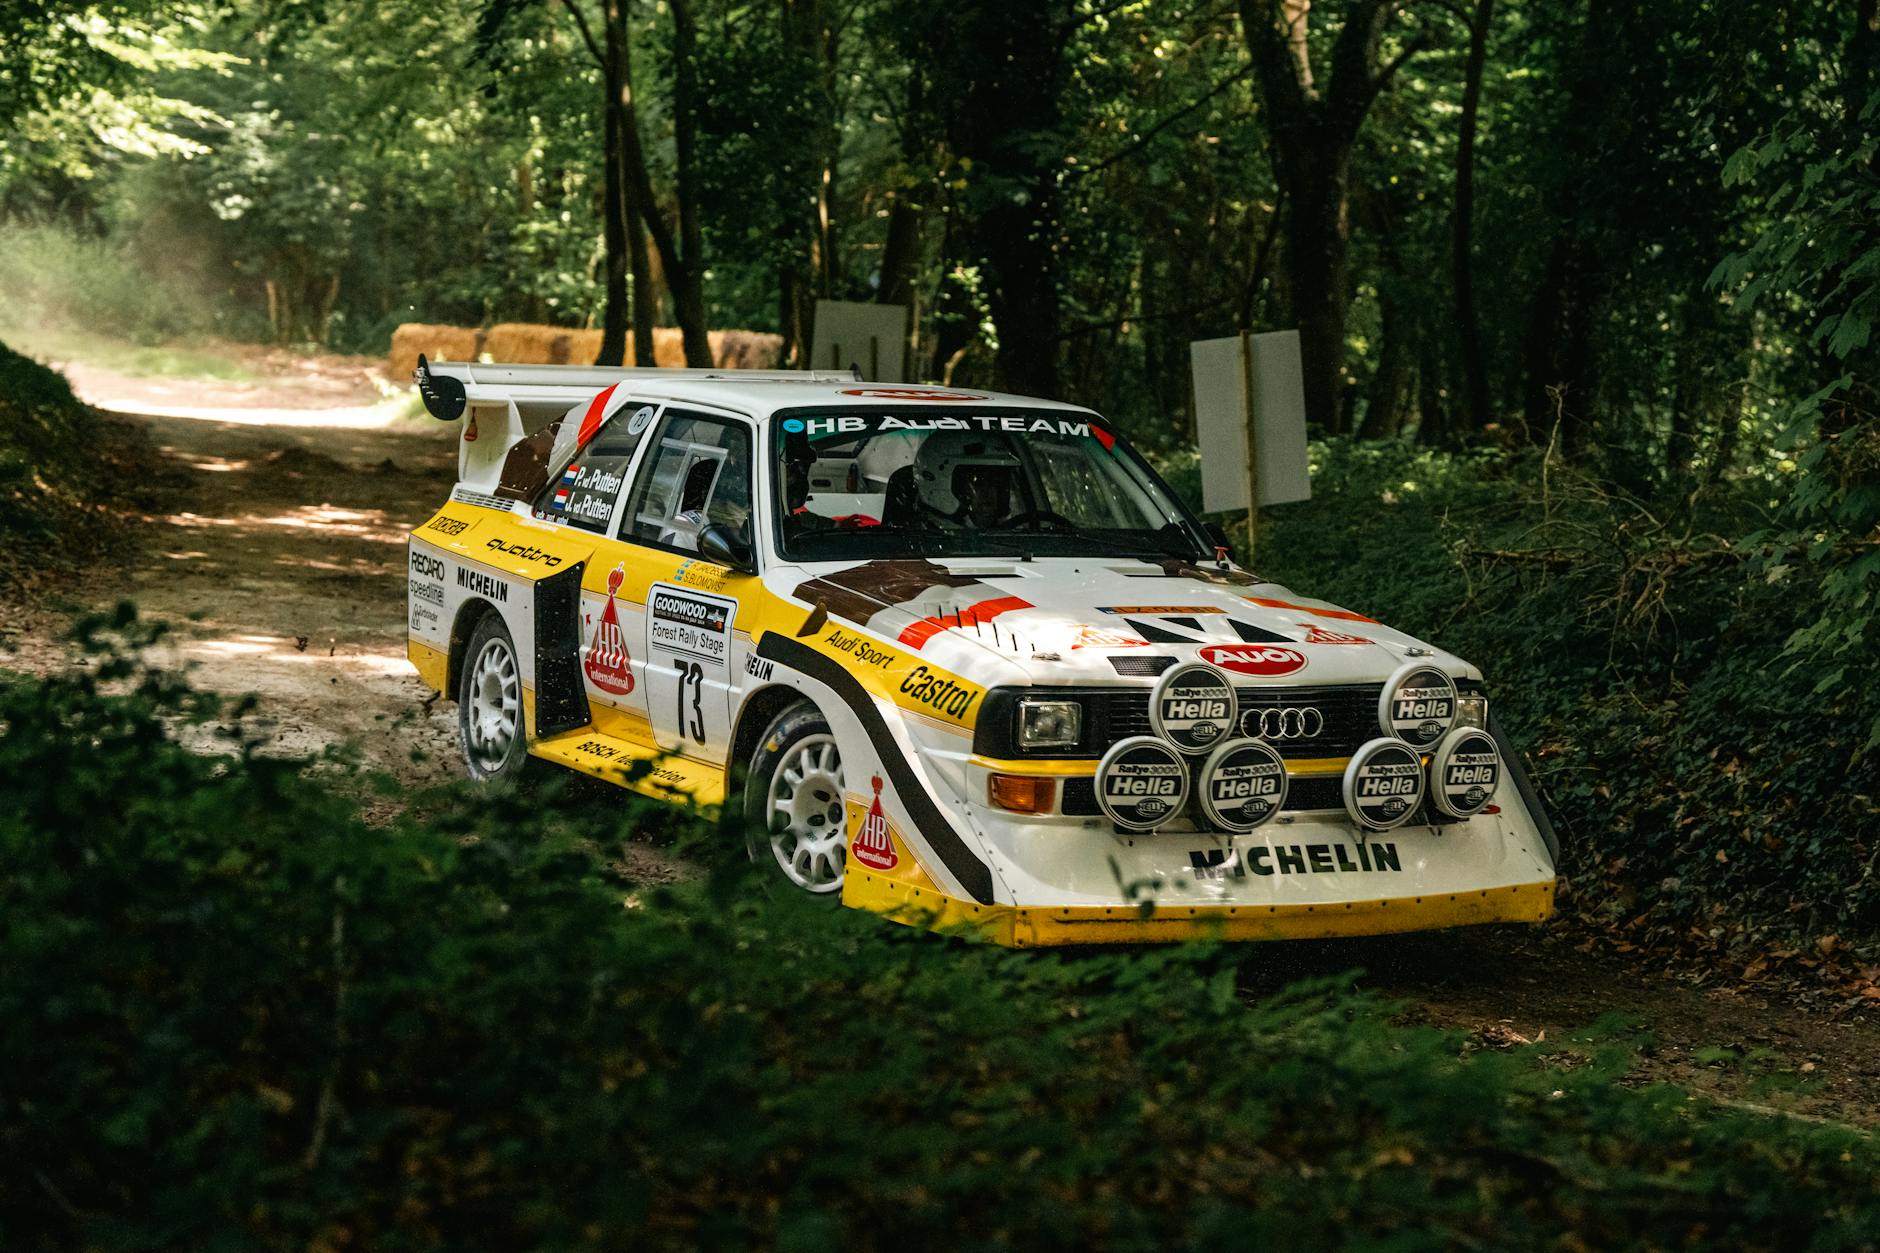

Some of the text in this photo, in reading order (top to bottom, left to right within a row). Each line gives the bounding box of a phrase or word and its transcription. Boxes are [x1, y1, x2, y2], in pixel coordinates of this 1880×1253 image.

[634, 413, 647, 427] 73
[806, 416, 868, 434] HB
[972, 416, 1090, 437] TEAM
[574, 466, 586, 485] P.
[590, 469, 621, 494] Putten
[565, 491, 576, 512] J.
[580, 494, 612, 520] Putten
[486, 538, 562, 567] quattro
[411, 552, 445, 581] RECARO
[457, 566, 508, 603] MICHELIN
[655, 596, 707, 619] GOODWOOD
[596, 620, 622, 669] HB
[652, 622, 724, 654] Forest Rally Stage
[823, 630, 897, 670] Audi Sport
[674, 659, 706, 746] 73
[900, 665, 979, 720] Castrol
[1168, 700, 1226, 718] Hella
[1397, 700, 1449, 719] Hella
[575, 741, 621, 759] BOSCH
[1112, 777, 1176, 794] Hella
[1362, 777, 1415, 795] Hella
[1449, 766, 1493, 784] Hella
[1218, 778, 1276, 798] Hella
[864, 811, 887, 850] HB
[857, 846, 892, 867] international
